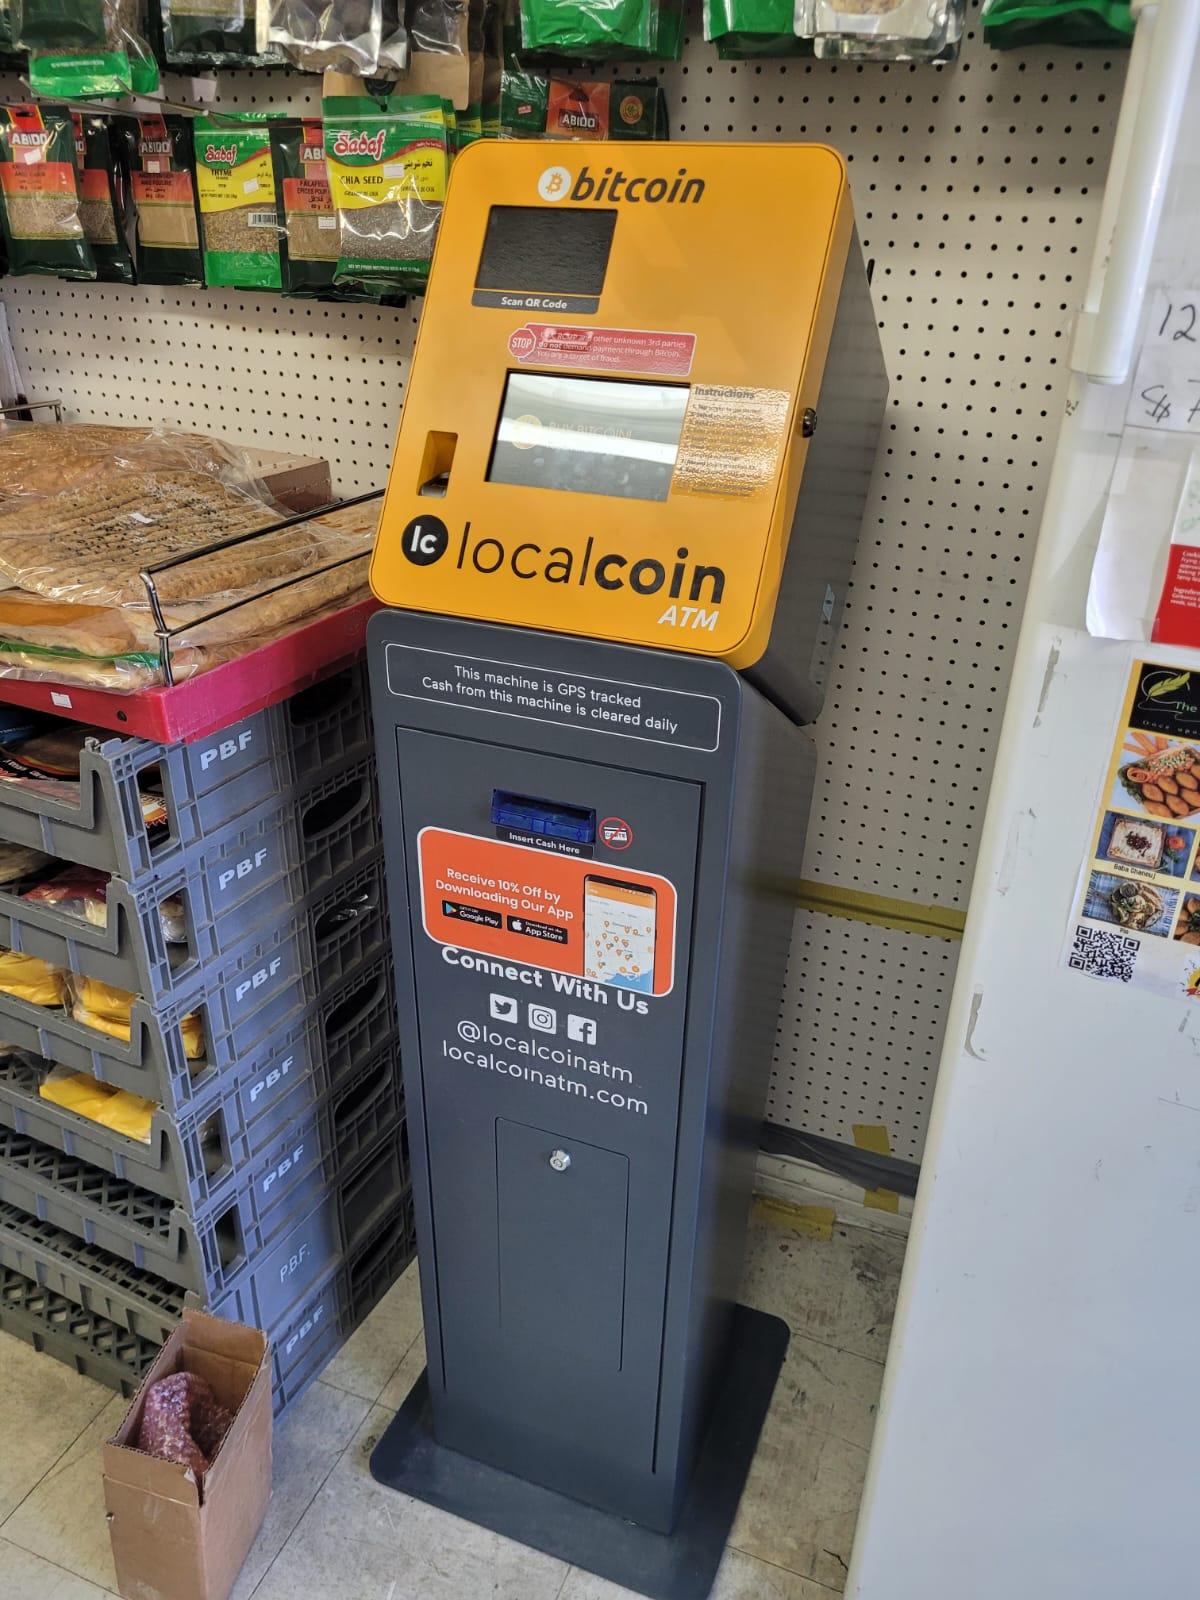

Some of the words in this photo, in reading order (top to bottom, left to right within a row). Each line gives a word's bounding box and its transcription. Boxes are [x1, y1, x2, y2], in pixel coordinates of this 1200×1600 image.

[562, 113, 596, 128] ABIDO
[205, 144, 237, 165] Sadaf
[303, 147, 326, 160] ABI
[333, 129, 385, 161] Sadaf
[340, 175, 360, 185] CHIA
[363, 176, 383, 185] SEED
[570, 166, 706, 204] bitcoin
[501, 296, 523, 308] Scan
[525, 297, 541, 309] QR
[542, 299, 567, 310] Code
[1158, 303, 1197, 342] 12
[511, 337, 532, 349] STOP
[694, 386, 756, 400] Instructions
[456, 520, 726, 605] localcoin
[656, 604, 720, 632] ATM
[422, 676, 453, 693] Cash
[456, 681, 486, 699] from
[489, 687, 513, 703] this
[517, 693, 572, 714] machine
[575, 703, 586, 716] is
[590, 706, 641, 726] cleared
[645, 716, 678, 735] daily
[453, 664, 480, 682] This
[484, 671, 539, 692] machine
[542, 681, 553, 693] is
[557, 683, 586, 699] GPS
[590, 688, 641, 709] tracked
[1176, 701, 1198, 713] The
[200, 729, 253, 771] PBF
[509, 831, 534, 845] Insert
[535, 836, 557, 849] Cash
[558, 842, 581, 855] Here
[218, 847, 268, 891] PBF
[446, 867, 495, 888] Receive
[497, 879, 520, 893] 10%
[522, 884, 542, 900] Off
[544, 891, 561, 905] by
[435, 879, 519, 909] Downloading
[521, 899, 545, 914] Our
[547, 906, 574, 921] App
[459, 910, 484, 922] Google
[484, 916, 499, 926] Play
[525, 926, 541, 937] App
[542, 930, 563, 941] Store
[235, 956, 282, 1002] PBF
[441, 945, 543, 988] Connect
[550, 971, 608, 1005] With
[616, 989, 649, 1015] Us
[456, 1019, 634, 1084] @localcoinatm
[249, 1055, 295, 1103] PBF
[442, 1039, 648, 1115] localcoinatm.com
[263, 1145, 304, 1193] PBF
[286, 1305, 324, 1355] PBF
